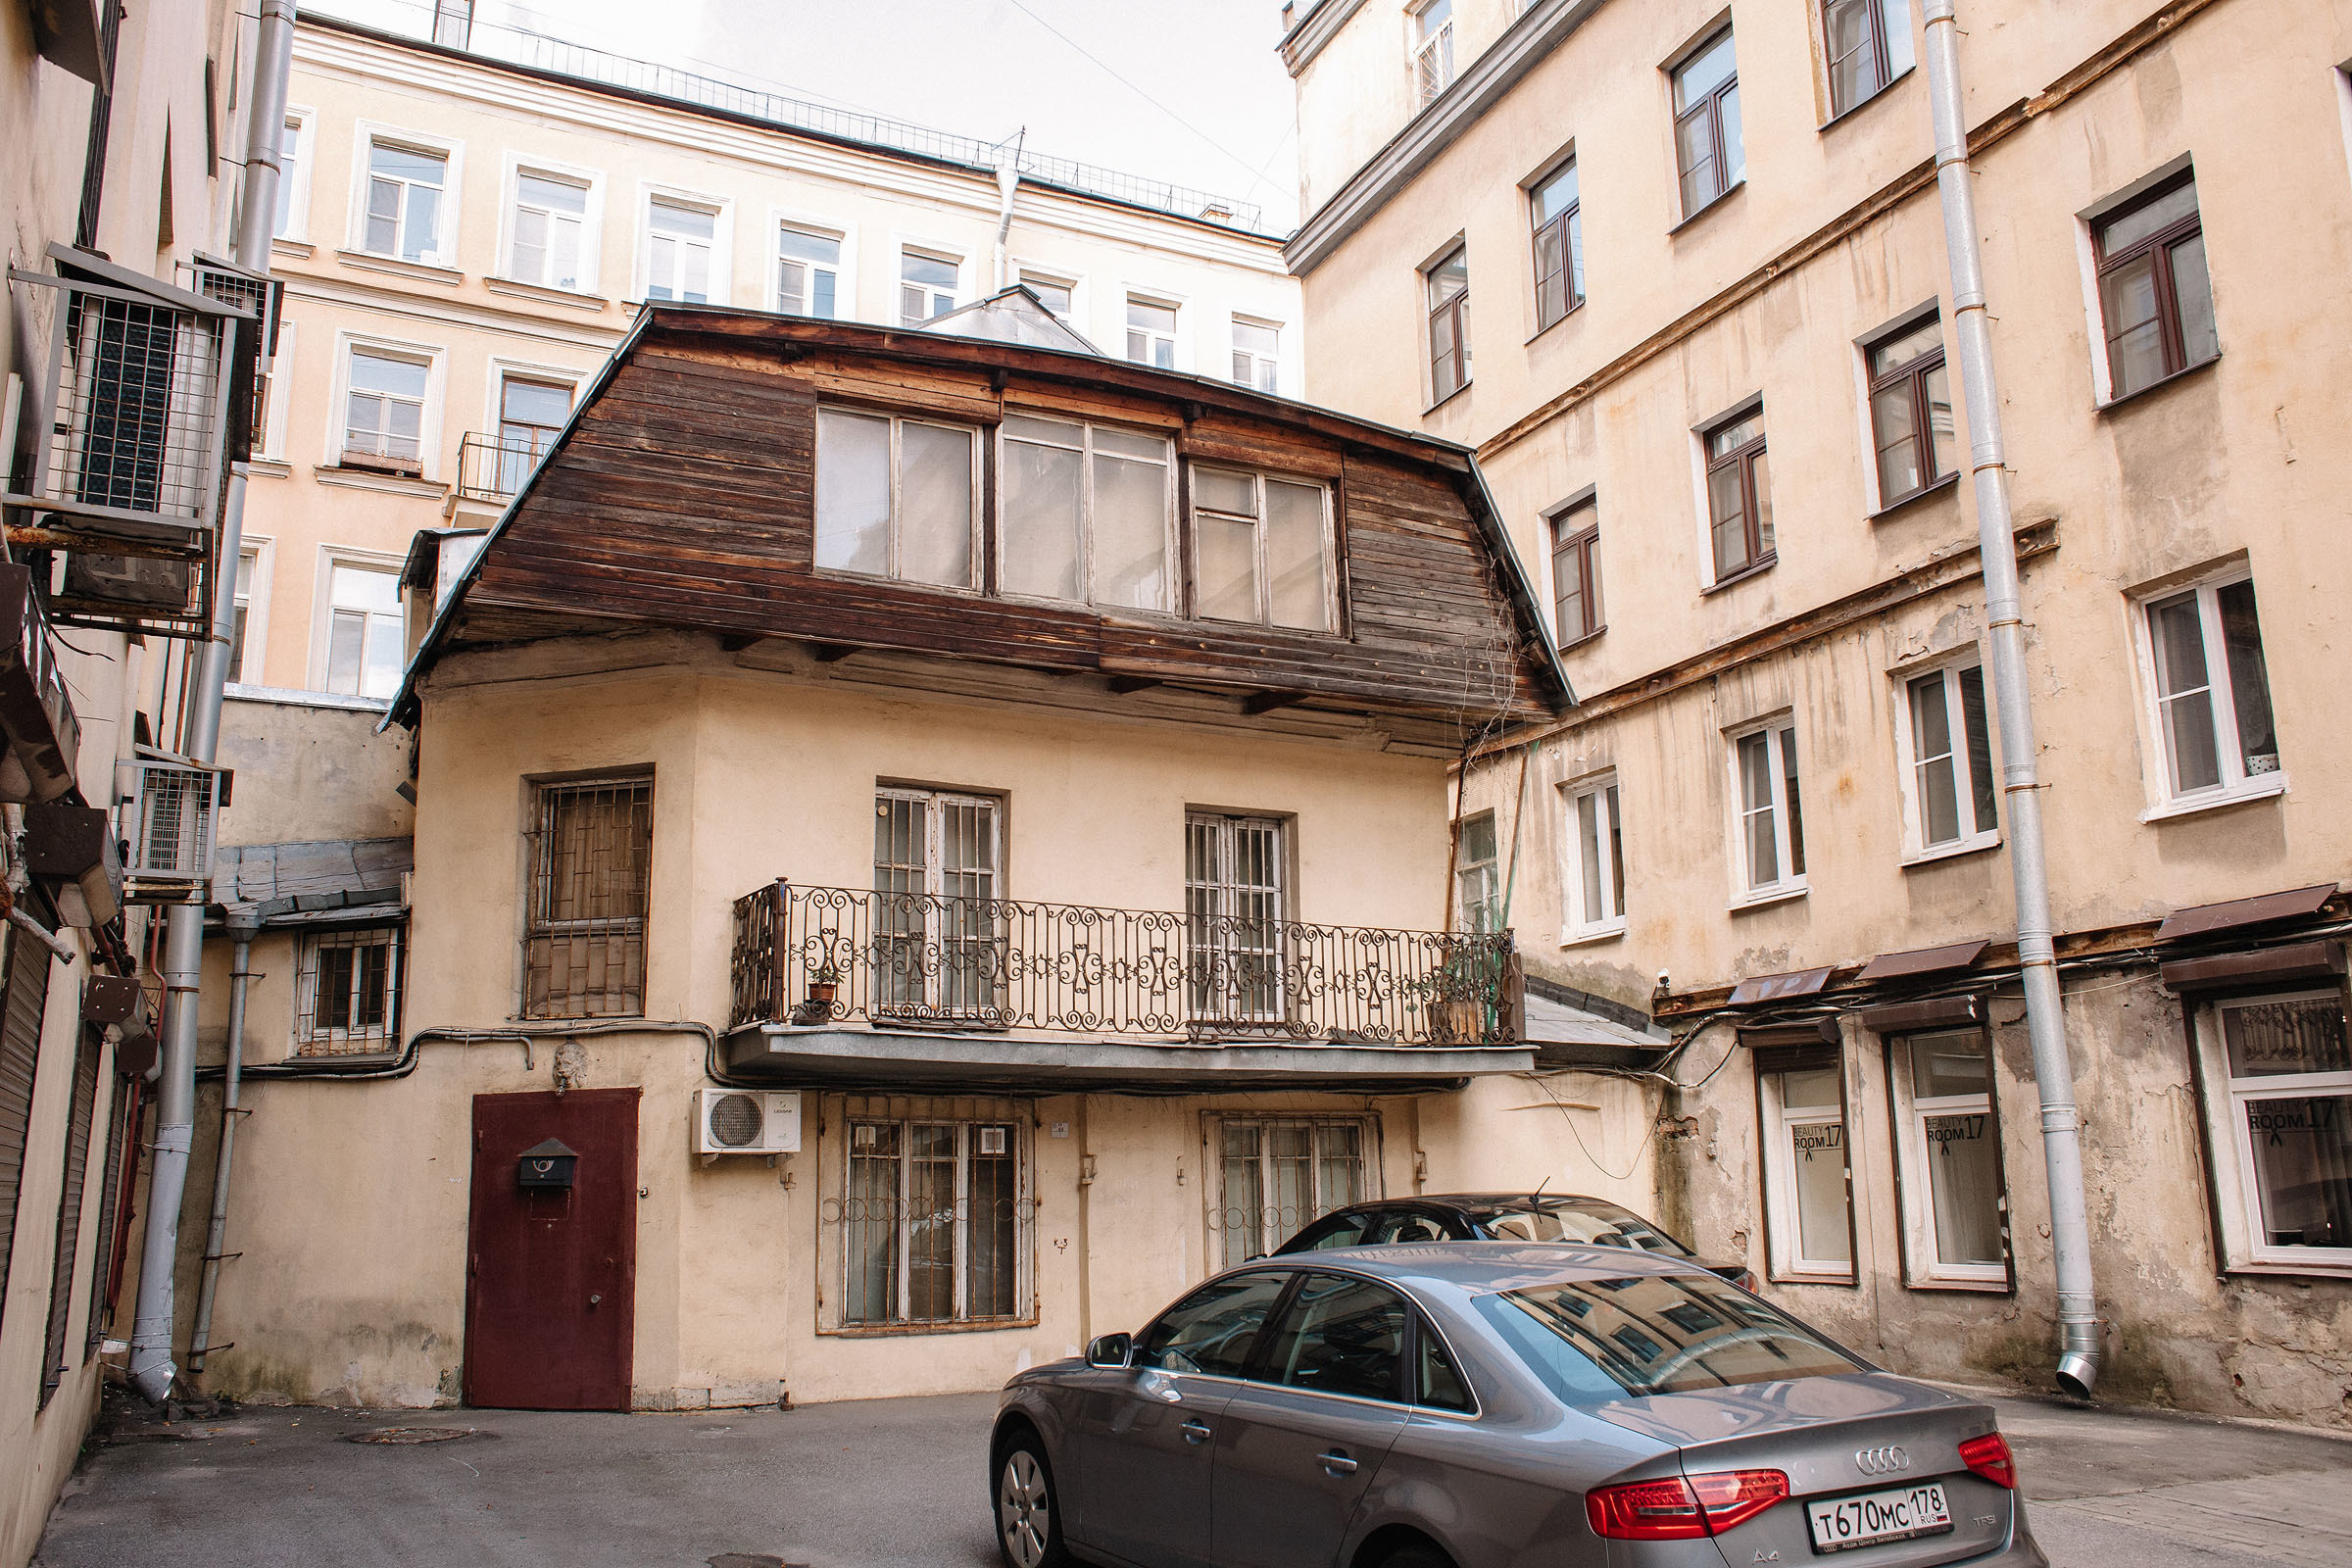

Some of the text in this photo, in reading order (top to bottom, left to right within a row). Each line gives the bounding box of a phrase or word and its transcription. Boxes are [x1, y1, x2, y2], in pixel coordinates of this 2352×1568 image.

[1926, 1117, 1962, 1129] BEAUTY
[2250, 1099, 2335, 1129] ROOM 17
[1793, 1126, 1824, 1137] BEAUTY
[1794, 1125, 1841, 1149] ROOM 17
[1927, 1115, 1984, 1142] ROOM 17
[1910, 1488, 1942, 1514] 178
[1921, 1514, 1936, 1525] RUS
[1753, 1547, 1779, 1563] A4
